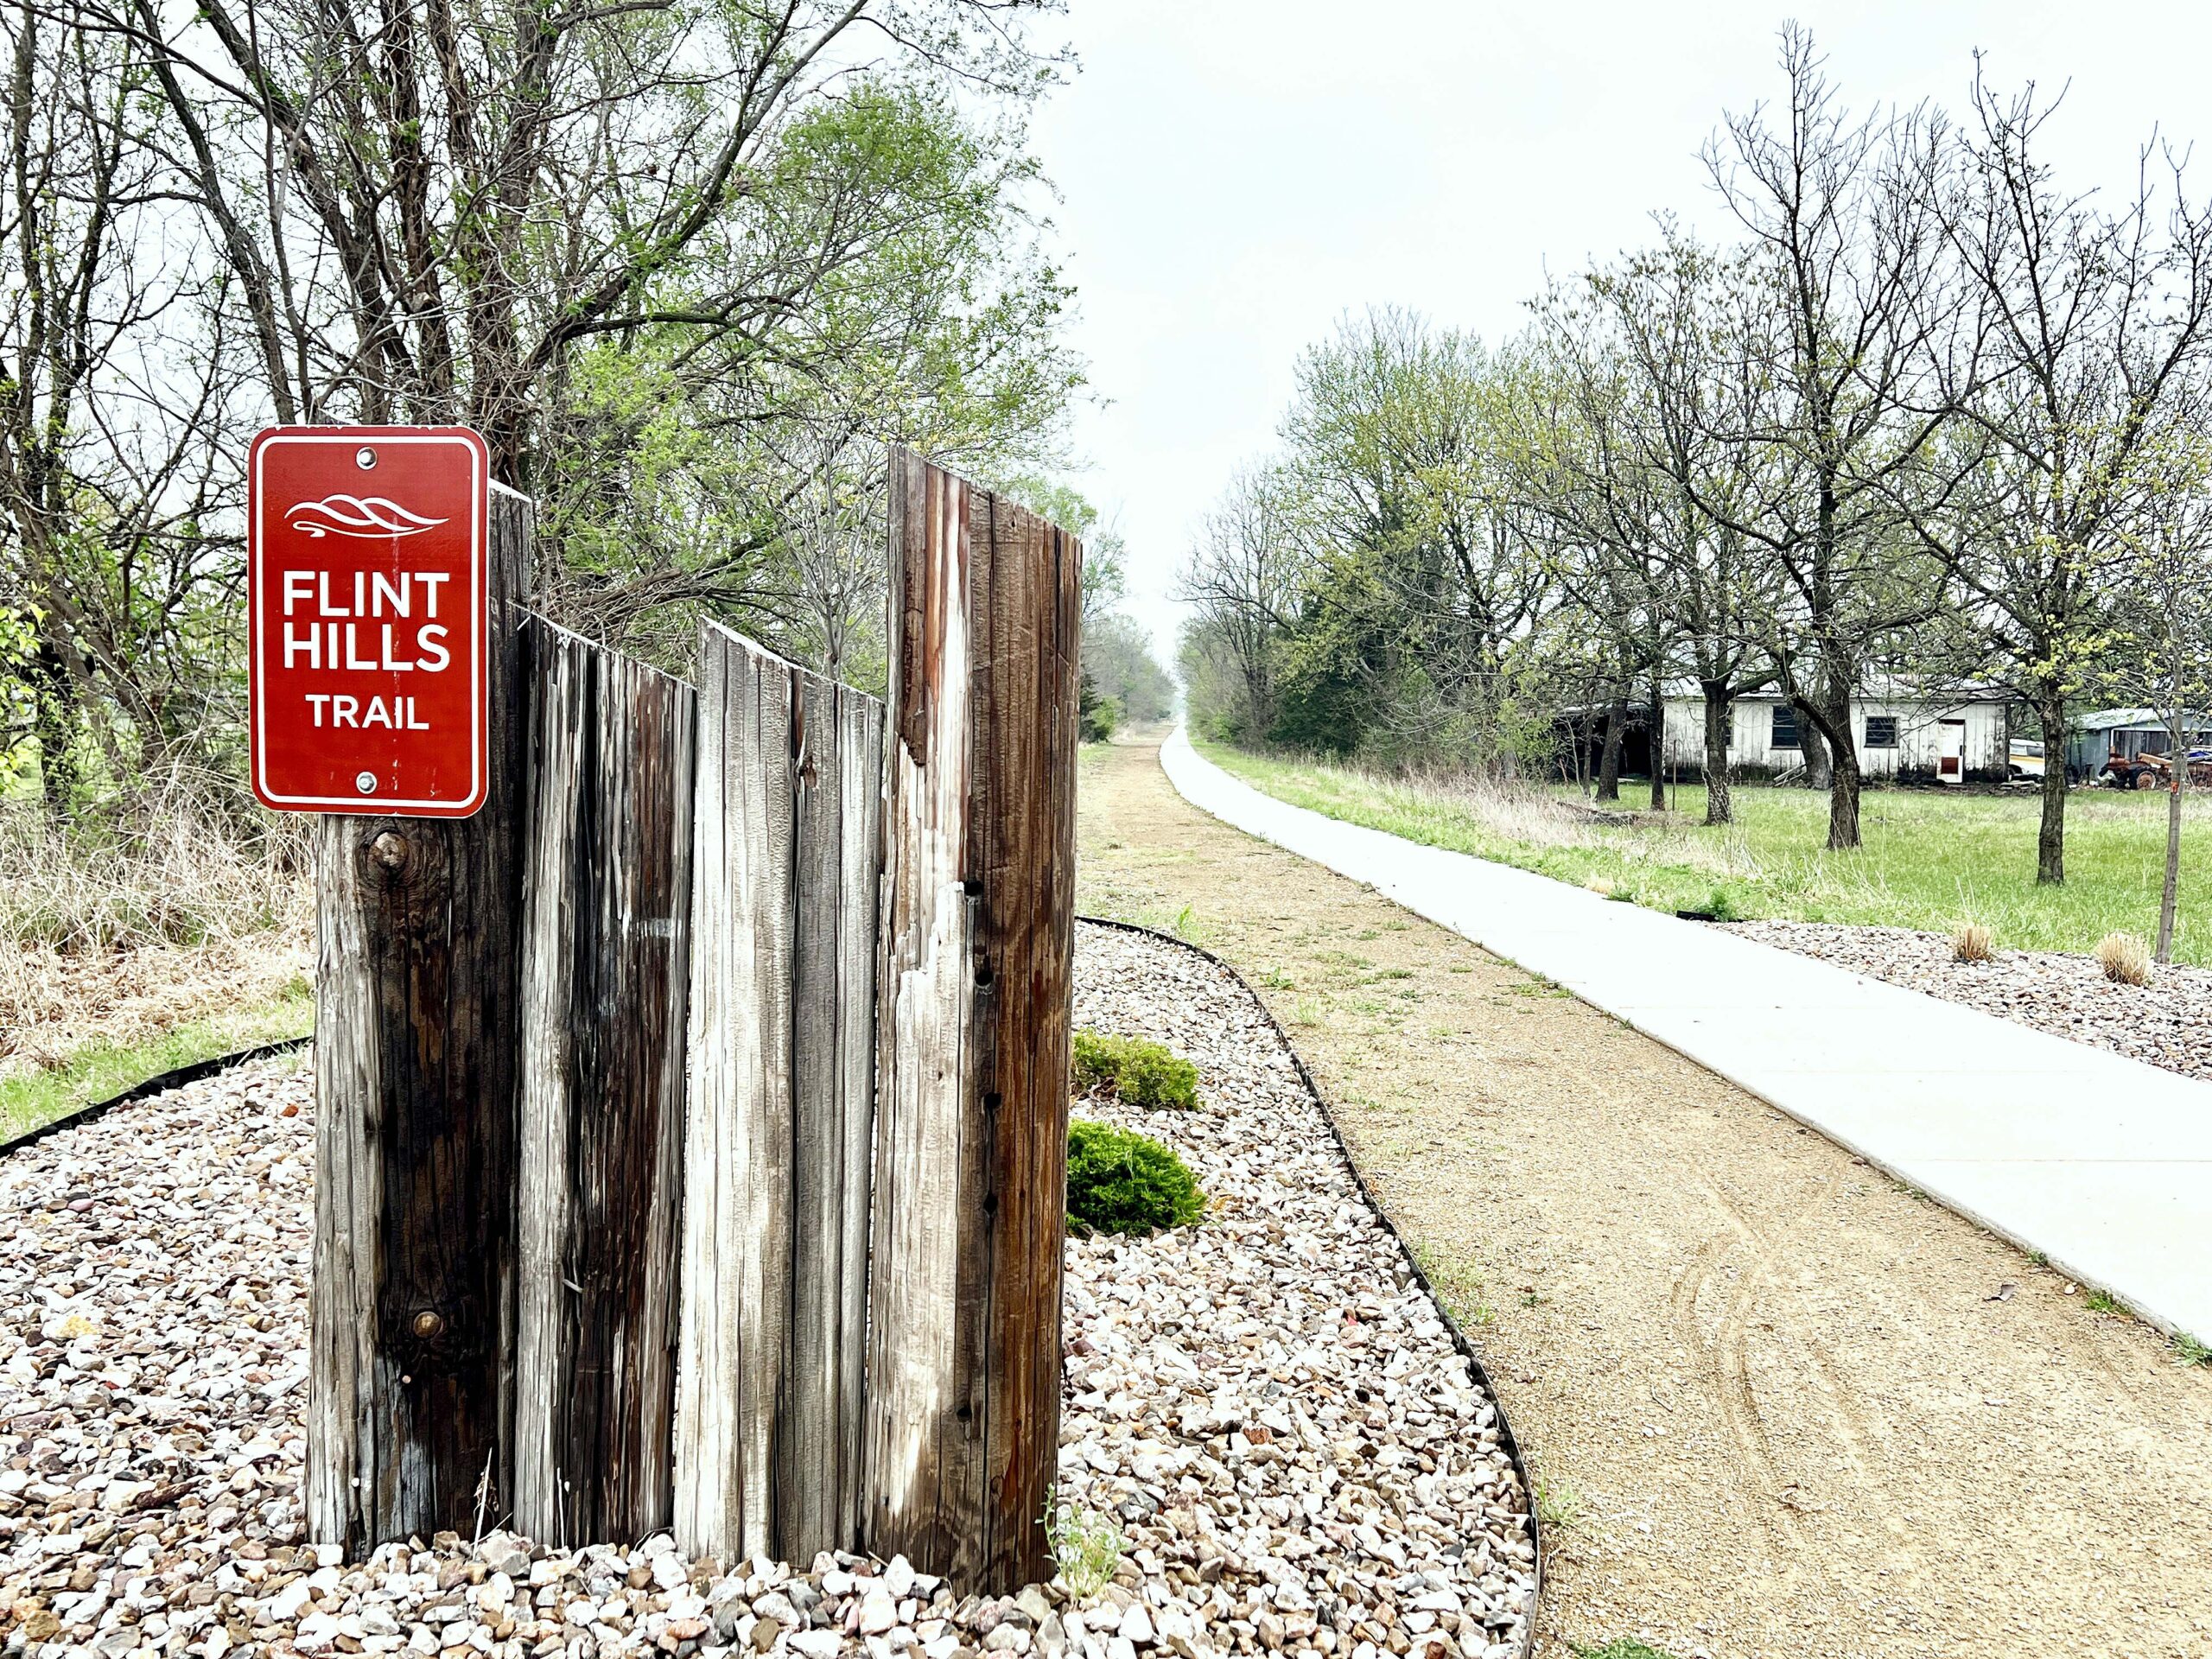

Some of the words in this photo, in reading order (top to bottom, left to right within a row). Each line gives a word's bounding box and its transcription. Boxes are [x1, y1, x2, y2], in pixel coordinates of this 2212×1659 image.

[283, 570, 450, 619] FLINT
[283, 621, 450, 672] HILLS
[304, 694, 429, 730] TRAIL
